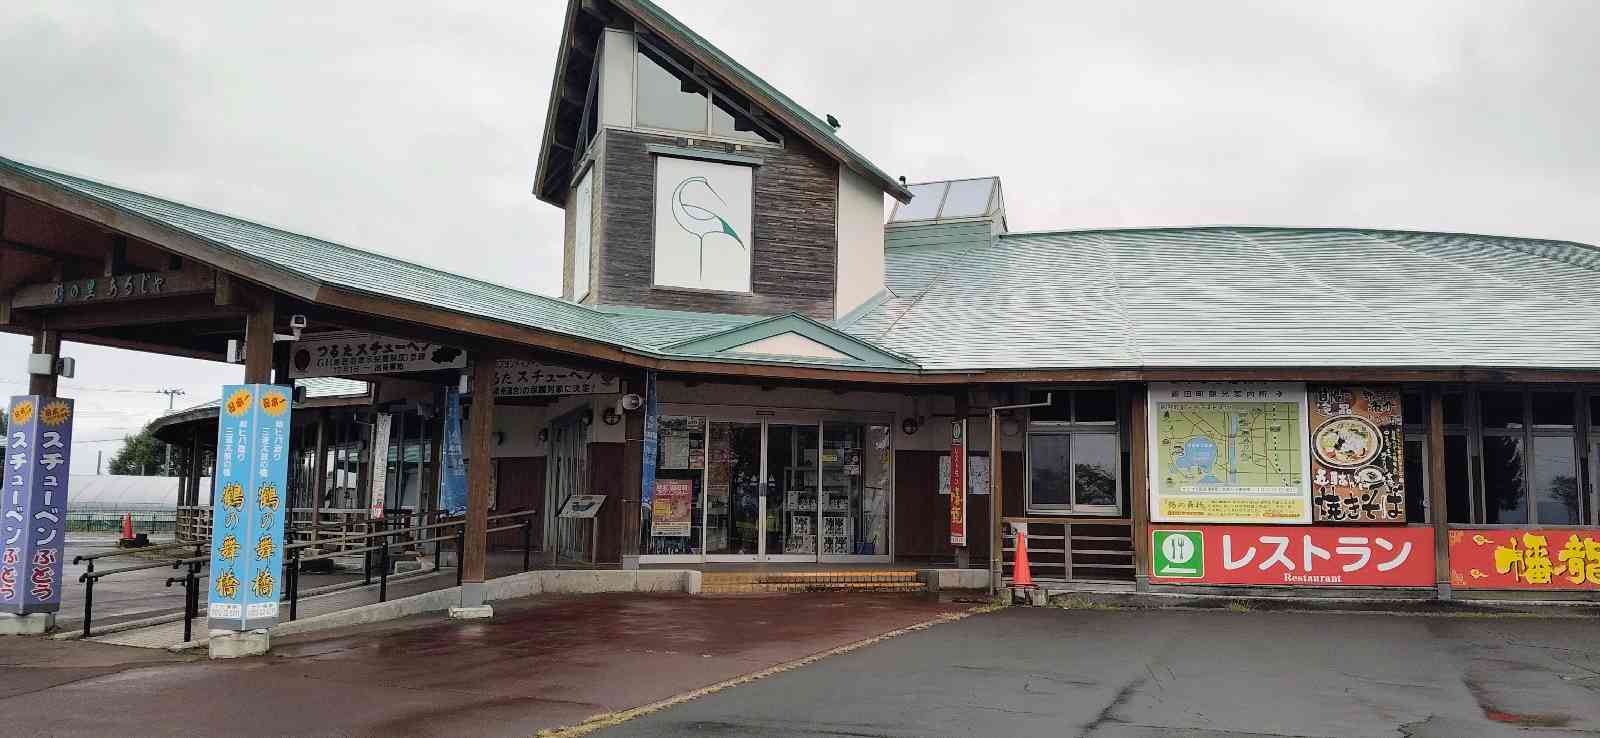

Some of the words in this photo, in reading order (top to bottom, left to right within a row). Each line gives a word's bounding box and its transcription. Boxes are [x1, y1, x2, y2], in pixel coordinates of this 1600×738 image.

[1314, 486, 1403, 521] 焼きそば
[216, 481, 245, 600] 鶴の舞橋
[250, 481, 281, 600] 鶴の舞橋
[1222, 534, 1413, 573] レストラン
[1283, 572, 1343, 584] Restaurant
